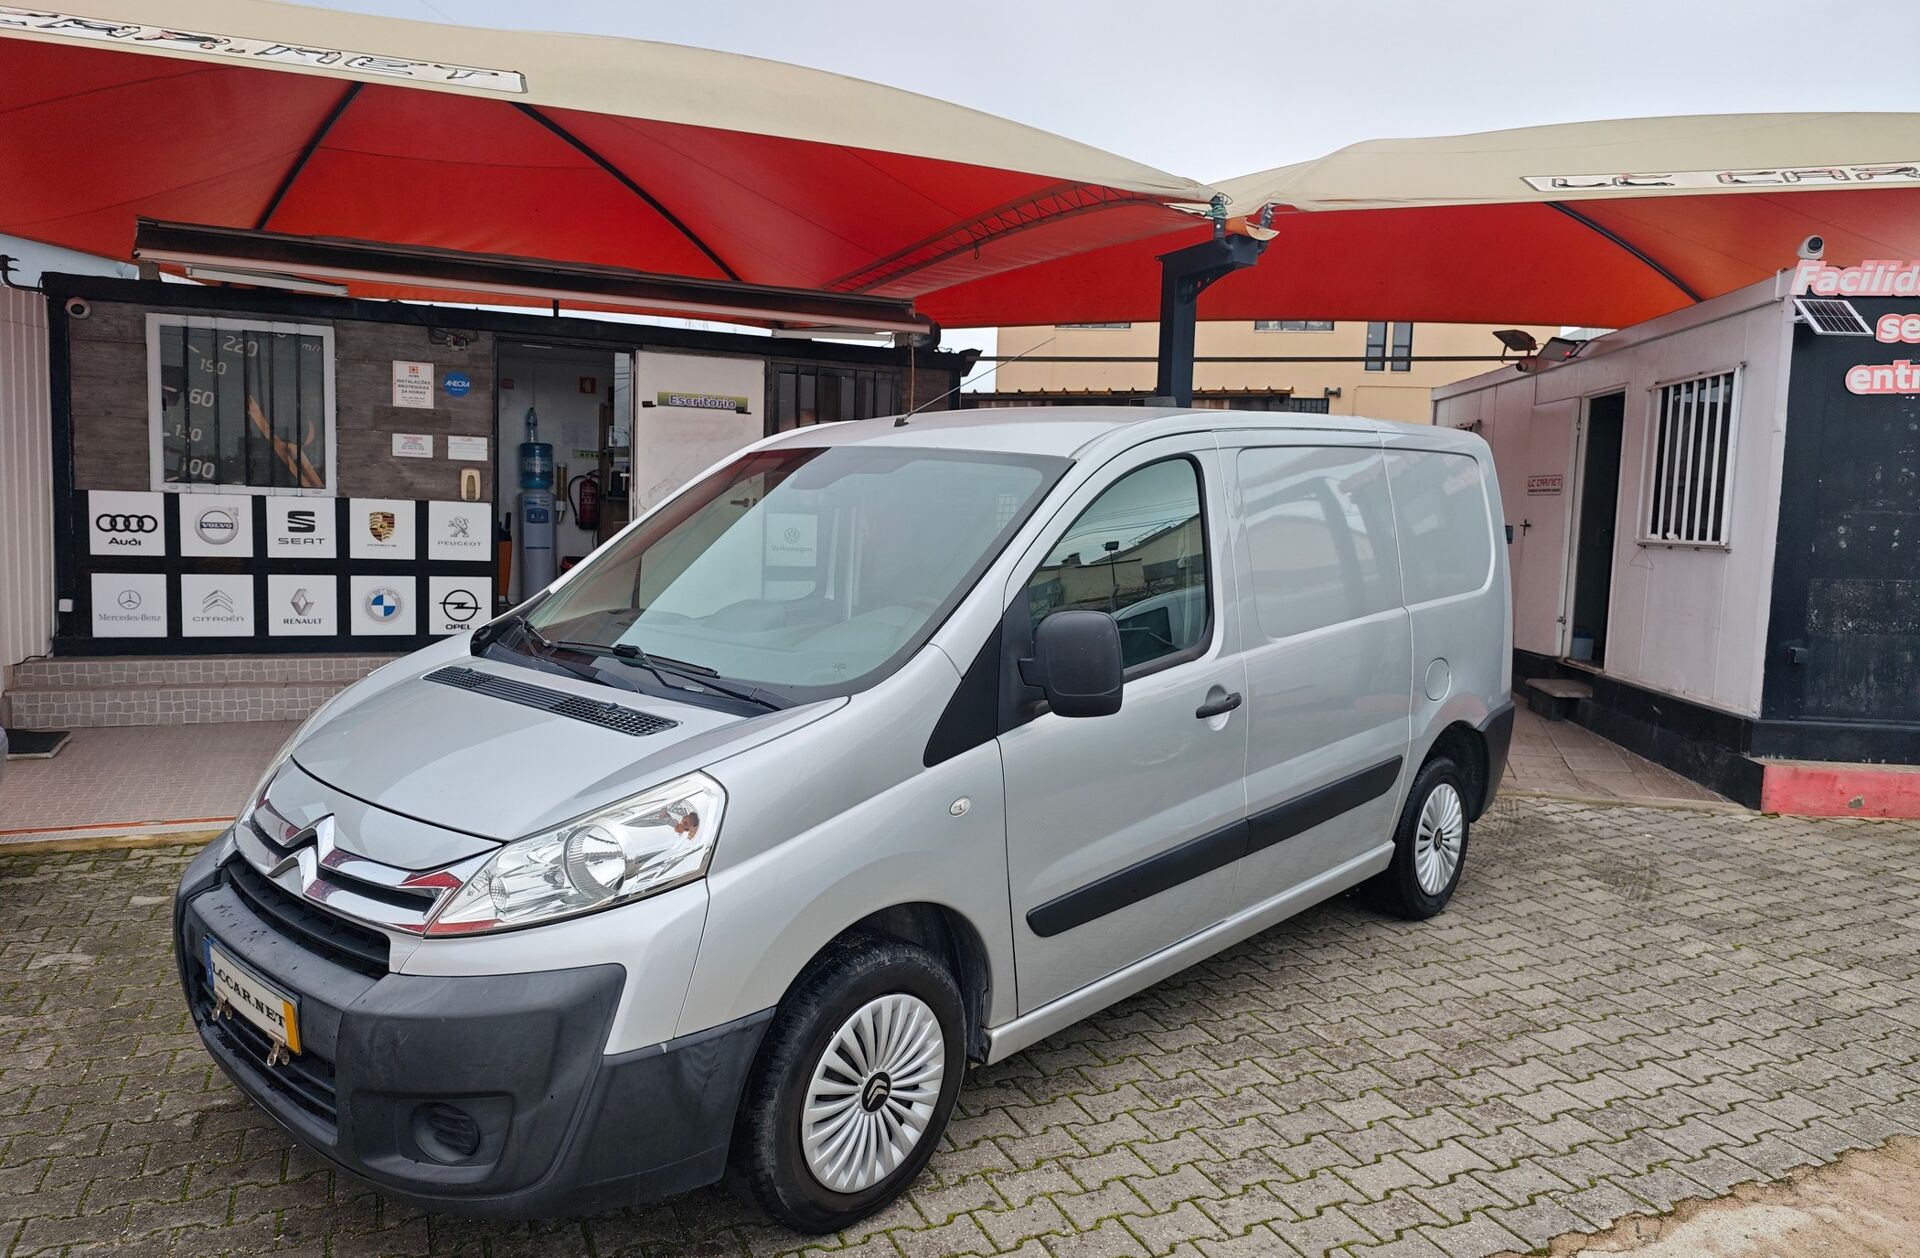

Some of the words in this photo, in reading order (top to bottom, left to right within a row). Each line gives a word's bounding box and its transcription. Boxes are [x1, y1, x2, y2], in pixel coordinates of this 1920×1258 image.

[1795, 264, 1920, 293] Facilid
[223, 335, 258, 357] 220
[670, 394, 736, 409] Escritório
[108, 537, 142, 546] Audi
[278, 537, 326, 545] SEAT
[771, 544, 813, 554] Volkswagen
[98, 613, 161, 621] Mercedes-Benz
[212, 961, 285, 1028] LCCAR.NET
